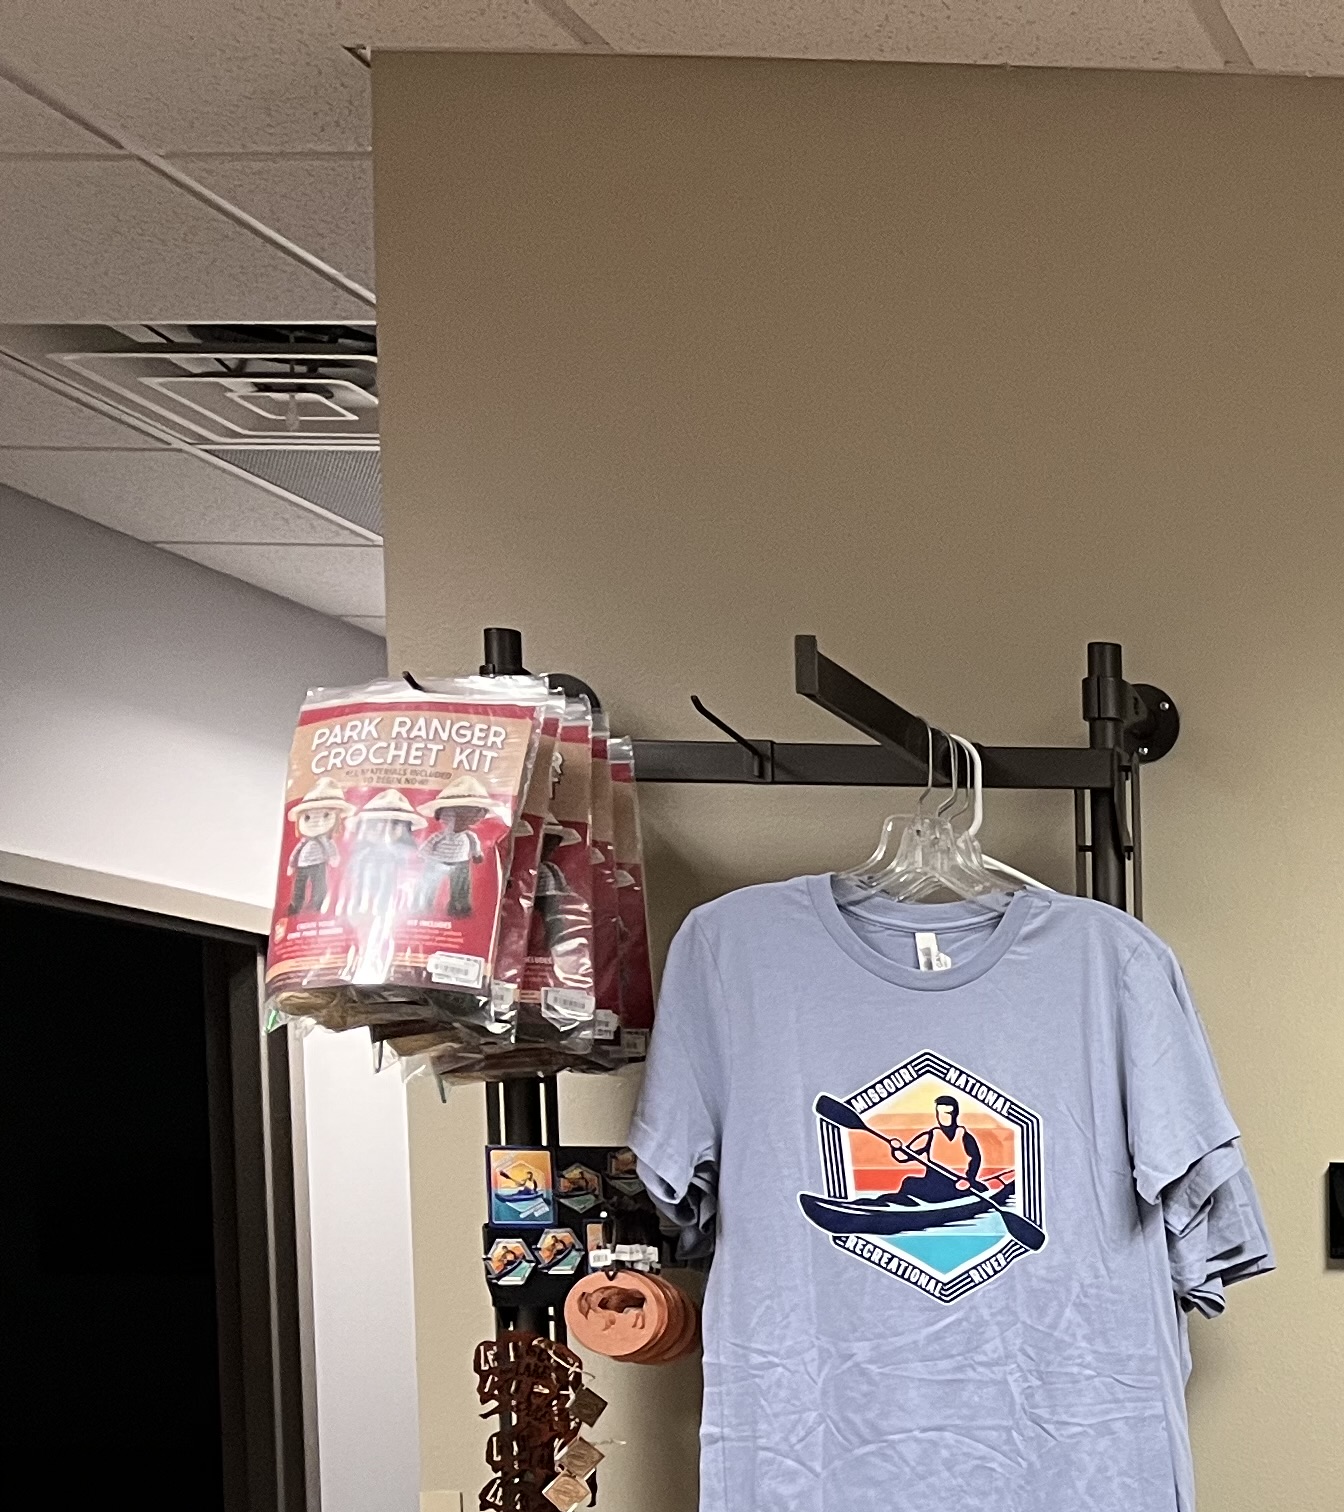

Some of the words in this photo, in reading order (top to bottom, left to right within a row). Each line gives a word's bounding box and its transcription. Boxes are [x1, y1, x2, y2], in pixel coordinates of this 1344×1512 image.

[310, 716, 382, 750] PARK
[391, 716, 507, 749] RANGER
[310, 741, 444, 775] CROCHET
[452, 747, 499, 774] KIT
[409, 769, 453, 780] INCLUDED
[376, 776, 402, 785] BEGIN
[850, 1063, 919, 1114] MISSOURI
[945, 1066, 1012, 1117] NATIONAL
[845, 1234, 944, 1298] RECREATIONAL
[968, 1252, 1009, 1285] RIVER
